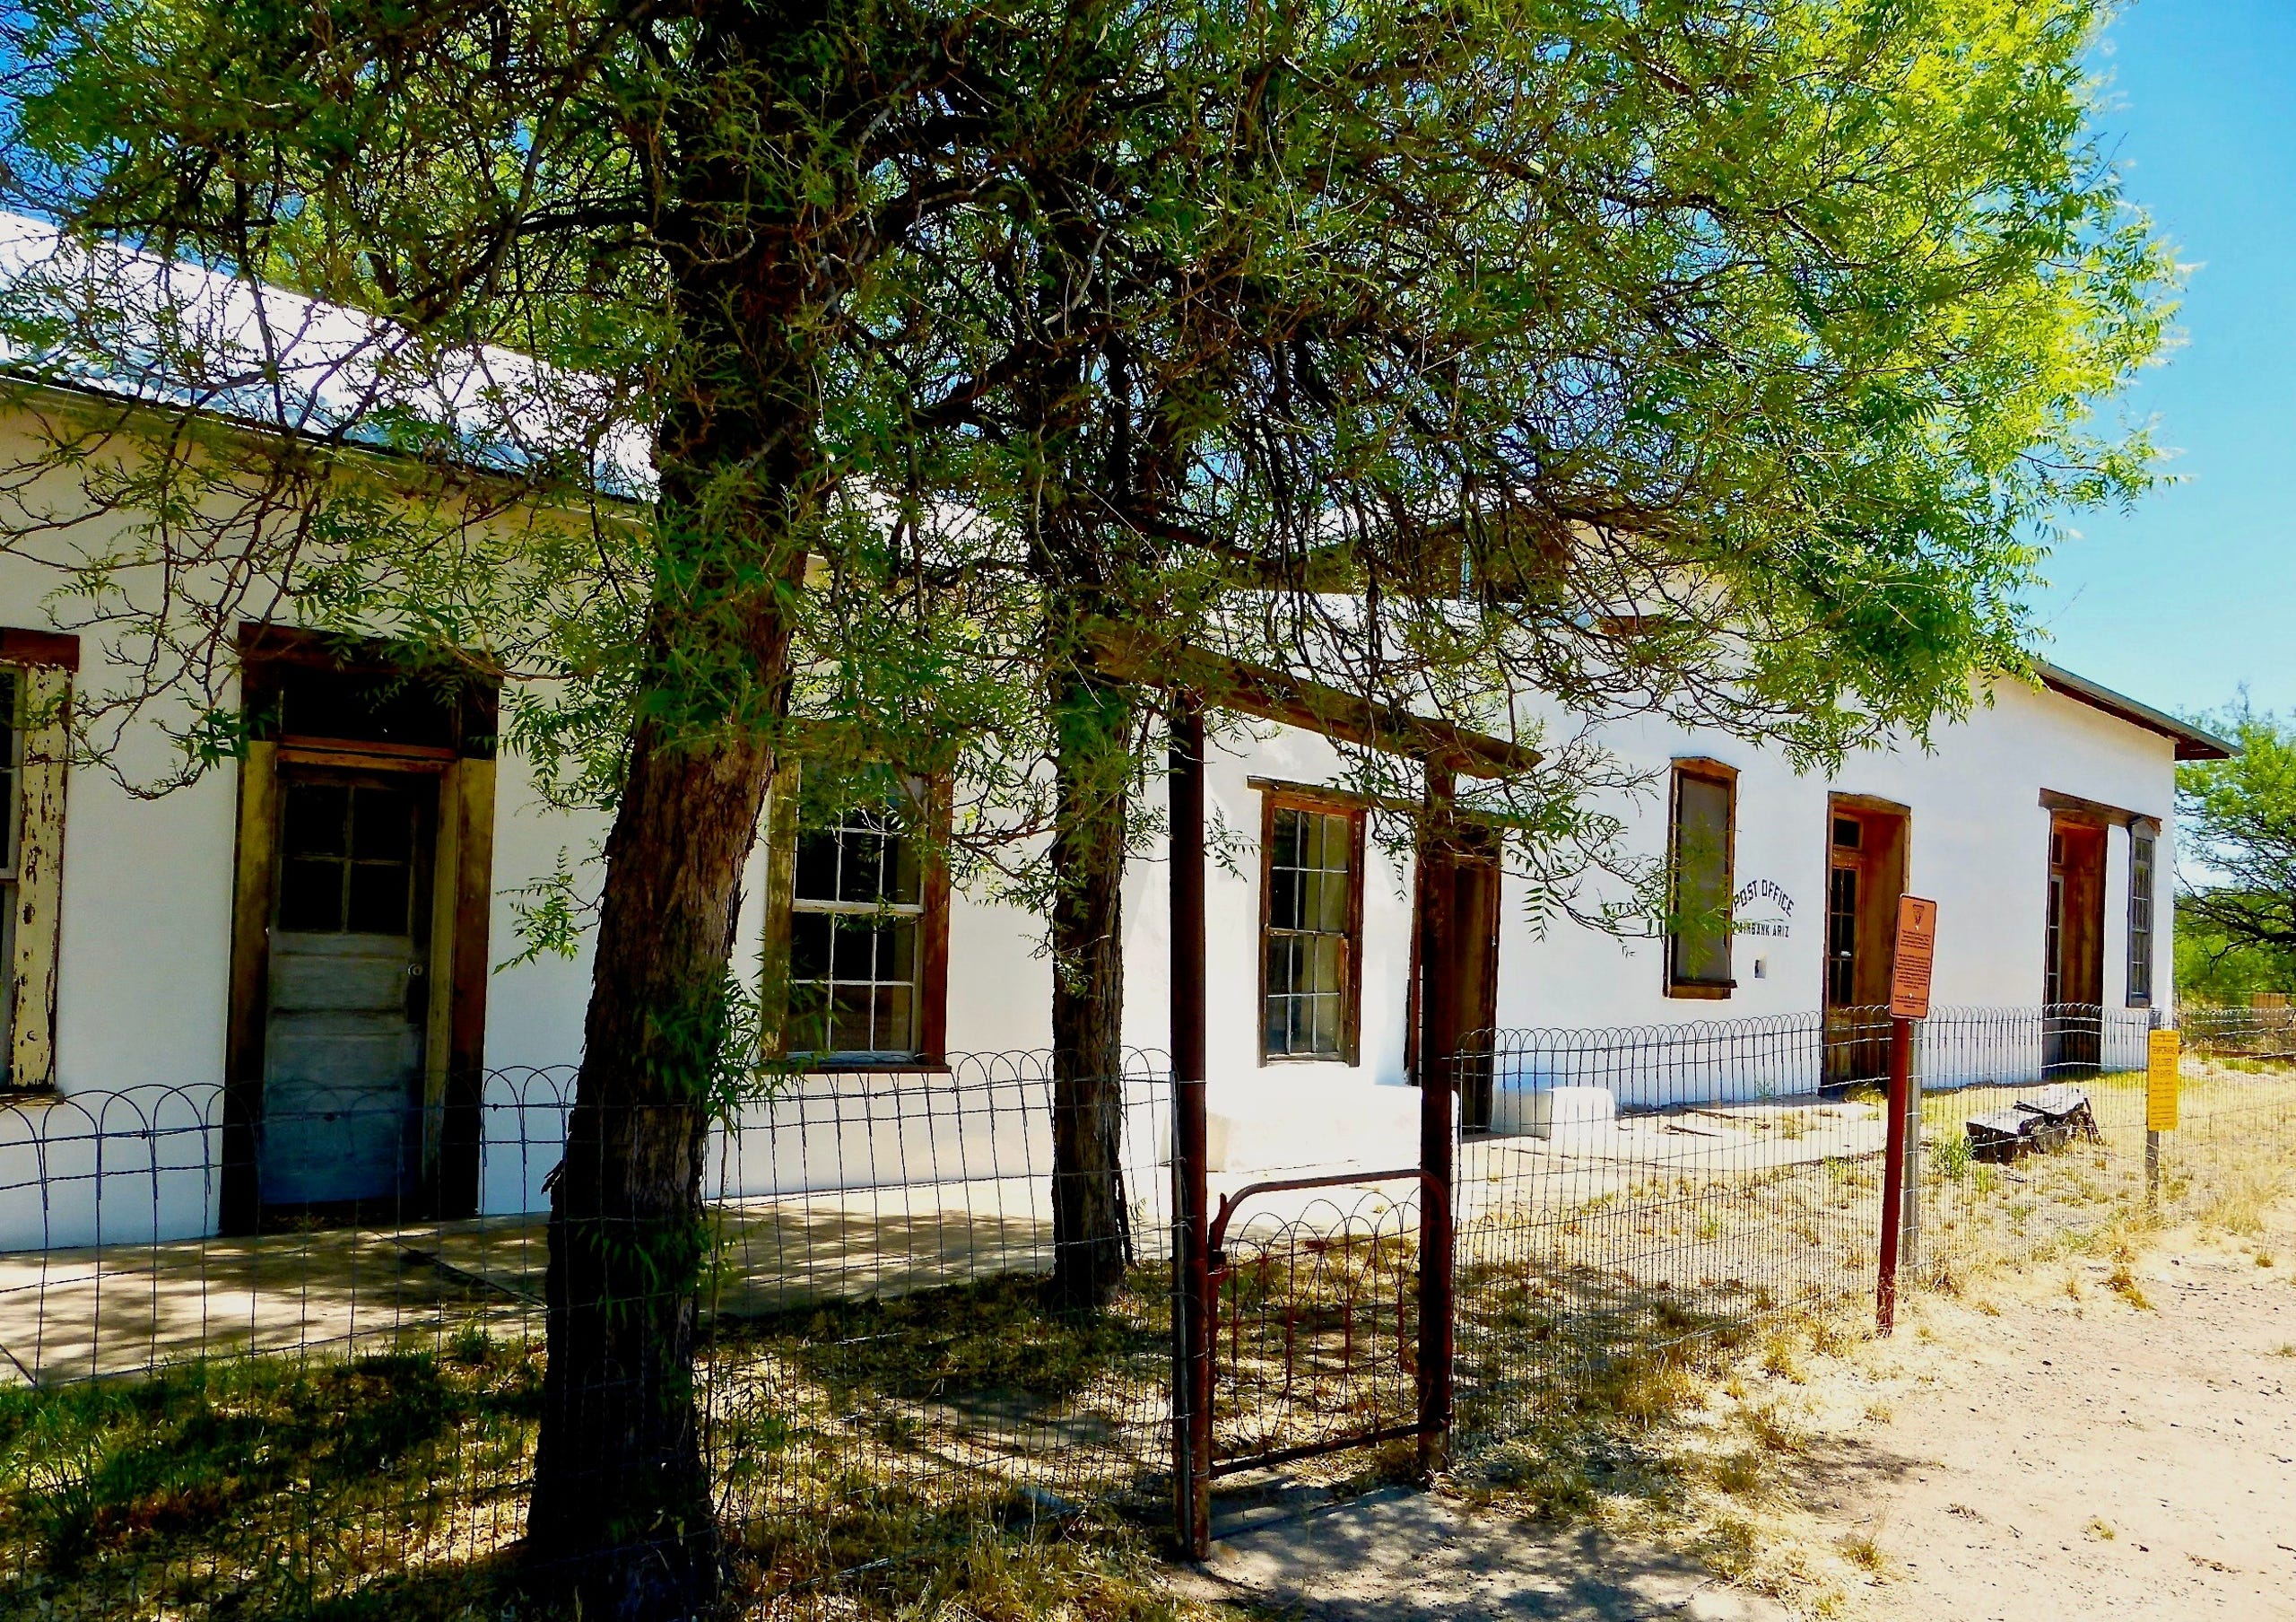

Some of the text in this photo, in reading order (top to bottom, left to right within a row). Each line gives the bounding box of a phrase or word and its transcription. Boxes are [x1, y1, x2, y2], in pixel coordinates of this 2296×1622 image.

[1732, 878, 1795, 918] POST OFFICE
[1771, 924, 1790, 938] ARIZ
